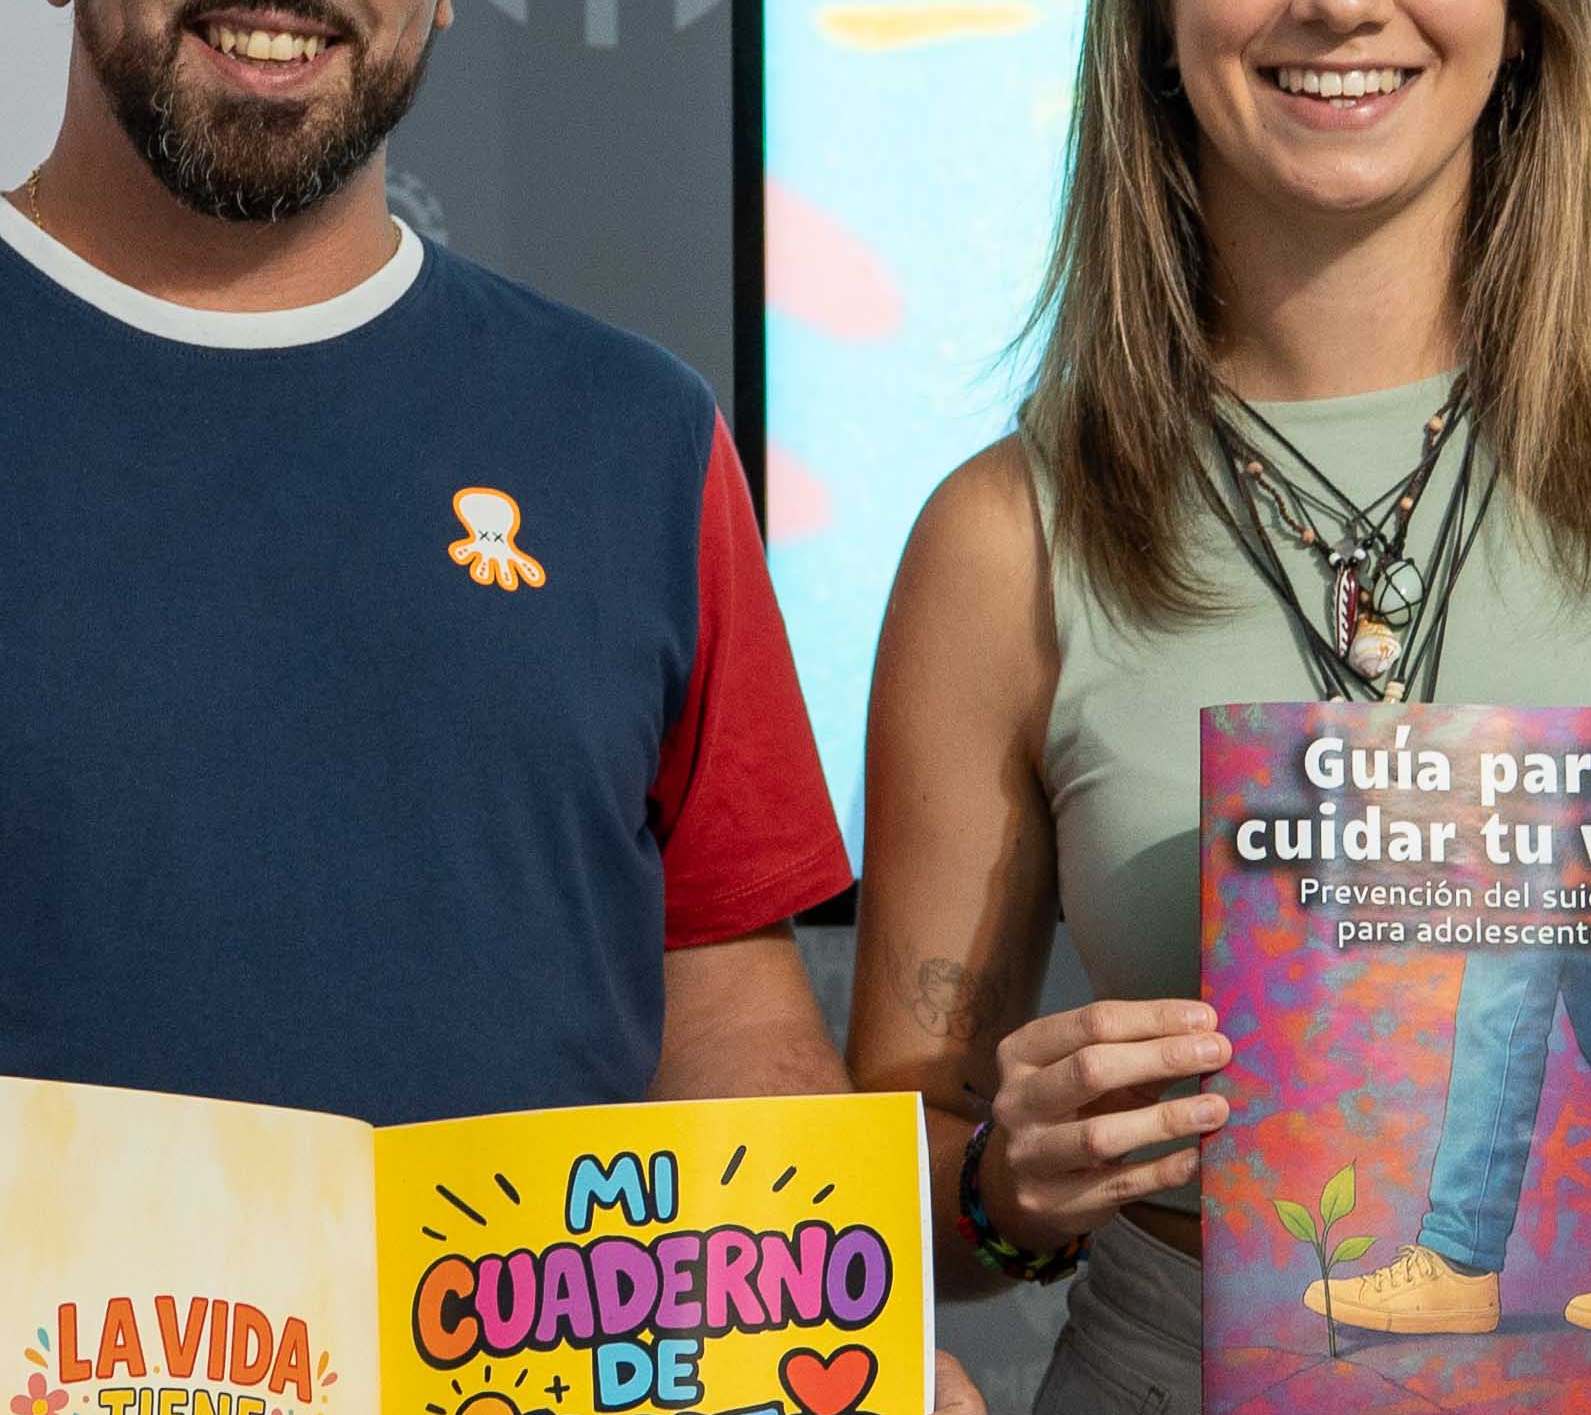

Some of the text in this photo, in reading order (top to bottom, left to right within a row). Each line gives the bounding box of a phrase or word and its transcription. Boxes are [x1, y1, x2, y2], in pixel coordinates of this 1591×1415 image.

[1304, 725, 1451, 793] Guía
[1236, 803, 1456, 862] cuidar
[1480, 812, 1554, 864] tu
[1300, 877, 1472, 908] Prevención
[1484, 880, 1530, 909] del
[1337, 918, 1406, 948] para
[564, 1150, 678, 1235] MI
[412, 1220, 893, 1370] CUADERNO
[58, 1295, 313, 1403] LA VIDA
[595, 1336, 704, 1413] DE
